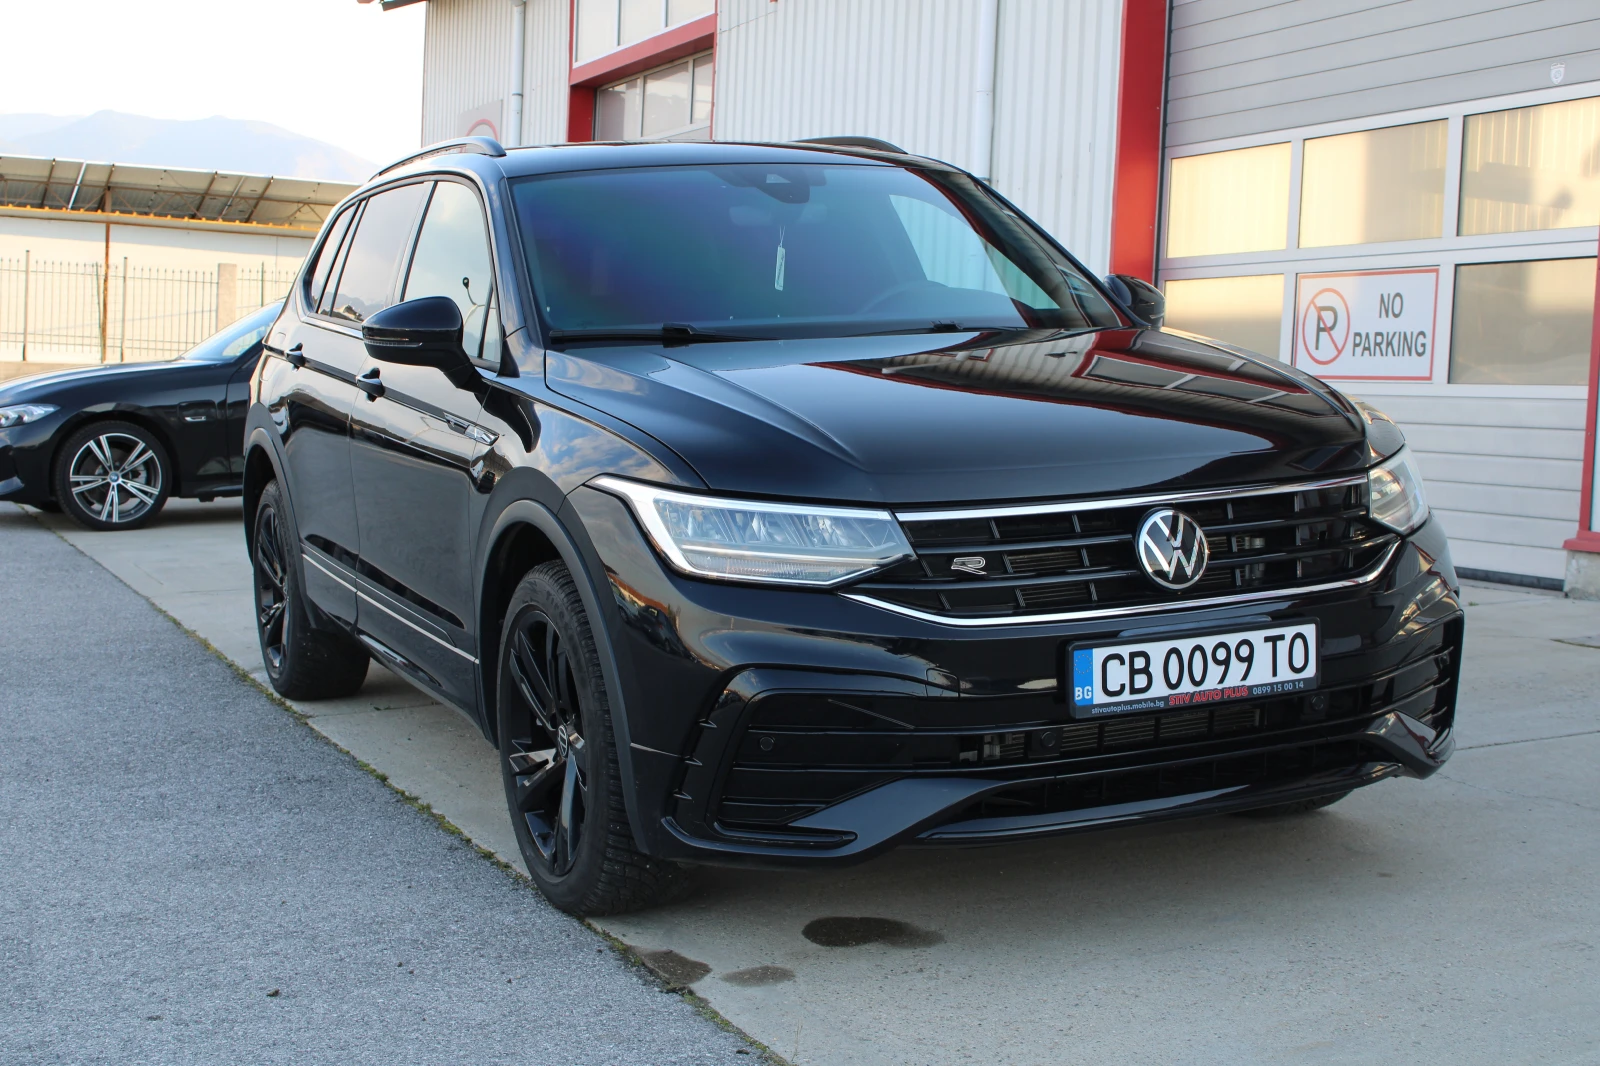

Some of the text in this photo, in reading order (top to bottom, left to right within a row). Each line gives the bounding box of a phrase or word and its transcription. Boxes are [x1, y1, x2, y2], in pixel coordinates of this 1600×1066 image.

[1379, 292, 1404, 318] NO
[1315, 305, 1338, 350] P
[1352, 330, 1427, 357] PARKING
[1137, 508, 1209, 590] VW
[1101, 631, 1310, 697] CB 0099 TO
[1075, 686, 1092, 700] BG
[1091, 681, 1304, 714] stivautoplus.mobile.bg STIV AUTO PLUS 0899 15 00 14
